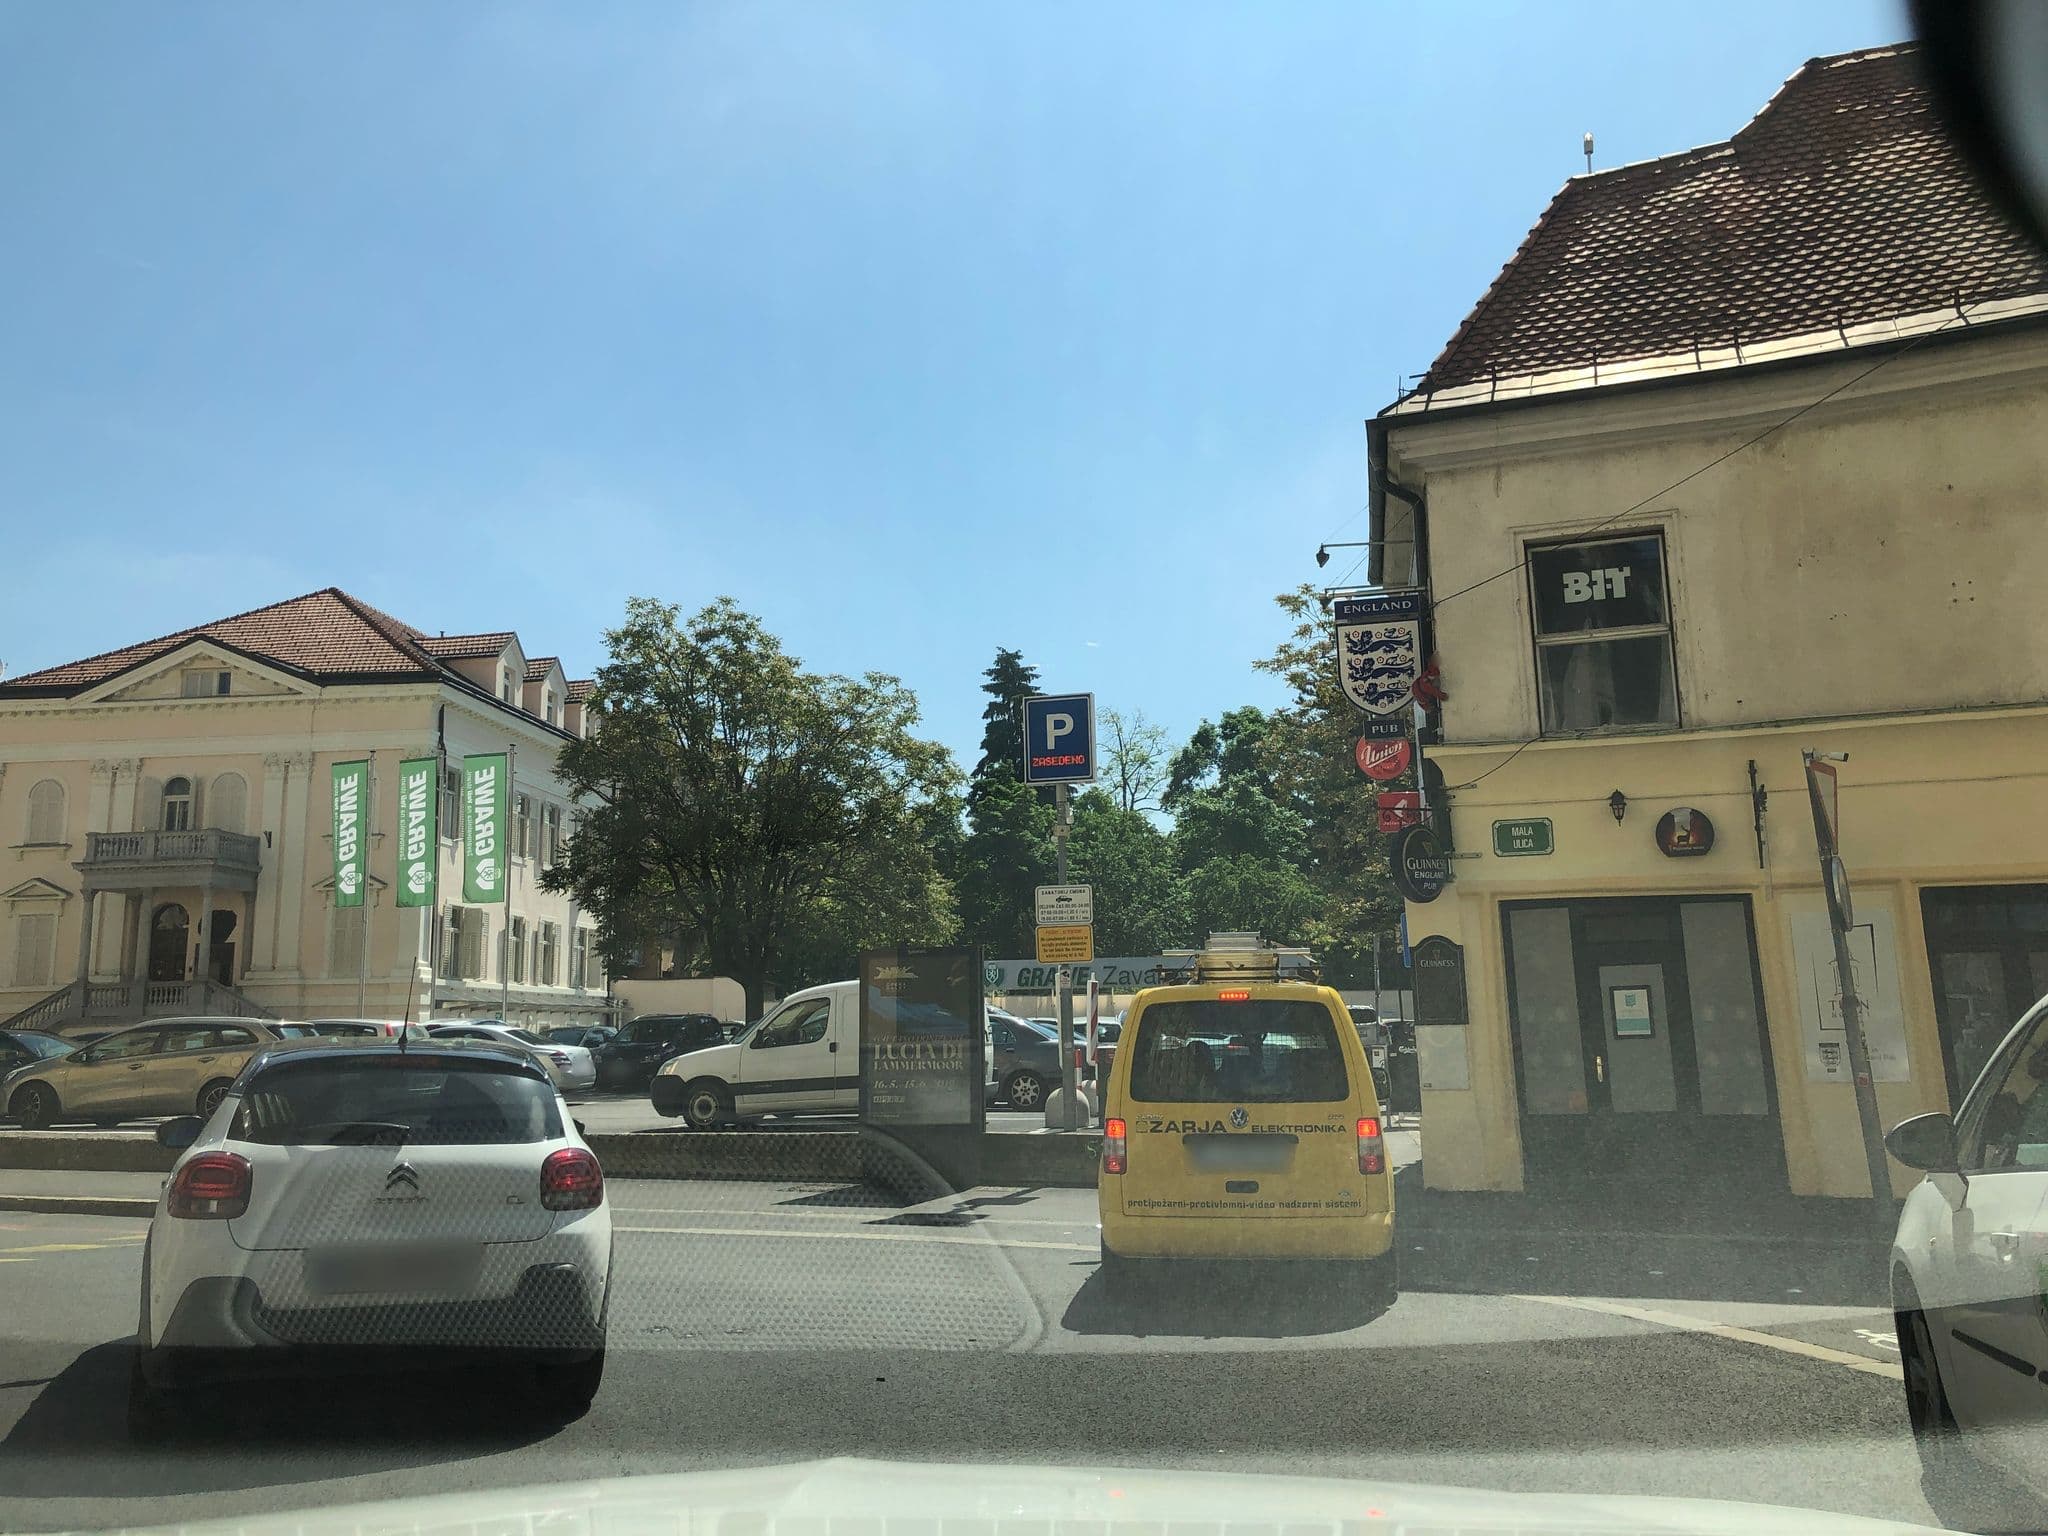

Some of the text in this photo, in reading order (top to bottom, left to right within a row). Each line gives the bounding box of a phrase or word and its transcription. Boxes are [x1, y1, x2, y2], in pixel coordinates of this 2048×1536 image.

[1343, 600, 1412, 614] ENGLAND
[1046, 713, 1074, 751] P
[1372, 724, 1399, 734] PUB
[1361, 742, 1404, 765] Union
[1031, 754, 1086, 768] ZASEDENO
[1511, 826, 1534, 837] MALA
[1512, 838, 1534, 849] ULICA
[1420, 959, 1455, 968] GUINNESS
[1828, 999, 1869, 1012] TN
[874, 1043, 964, 1060] LUCIA DI
[874, 1060, 964, 1071] LAMMERMOOR
[1149, 1120, 1347, 1133] ZARJA ELEKTRONIKA
[1279, 1199, 1322, 1209] nadzorni
[1325, 1198, 1362, 1209] sistemi
